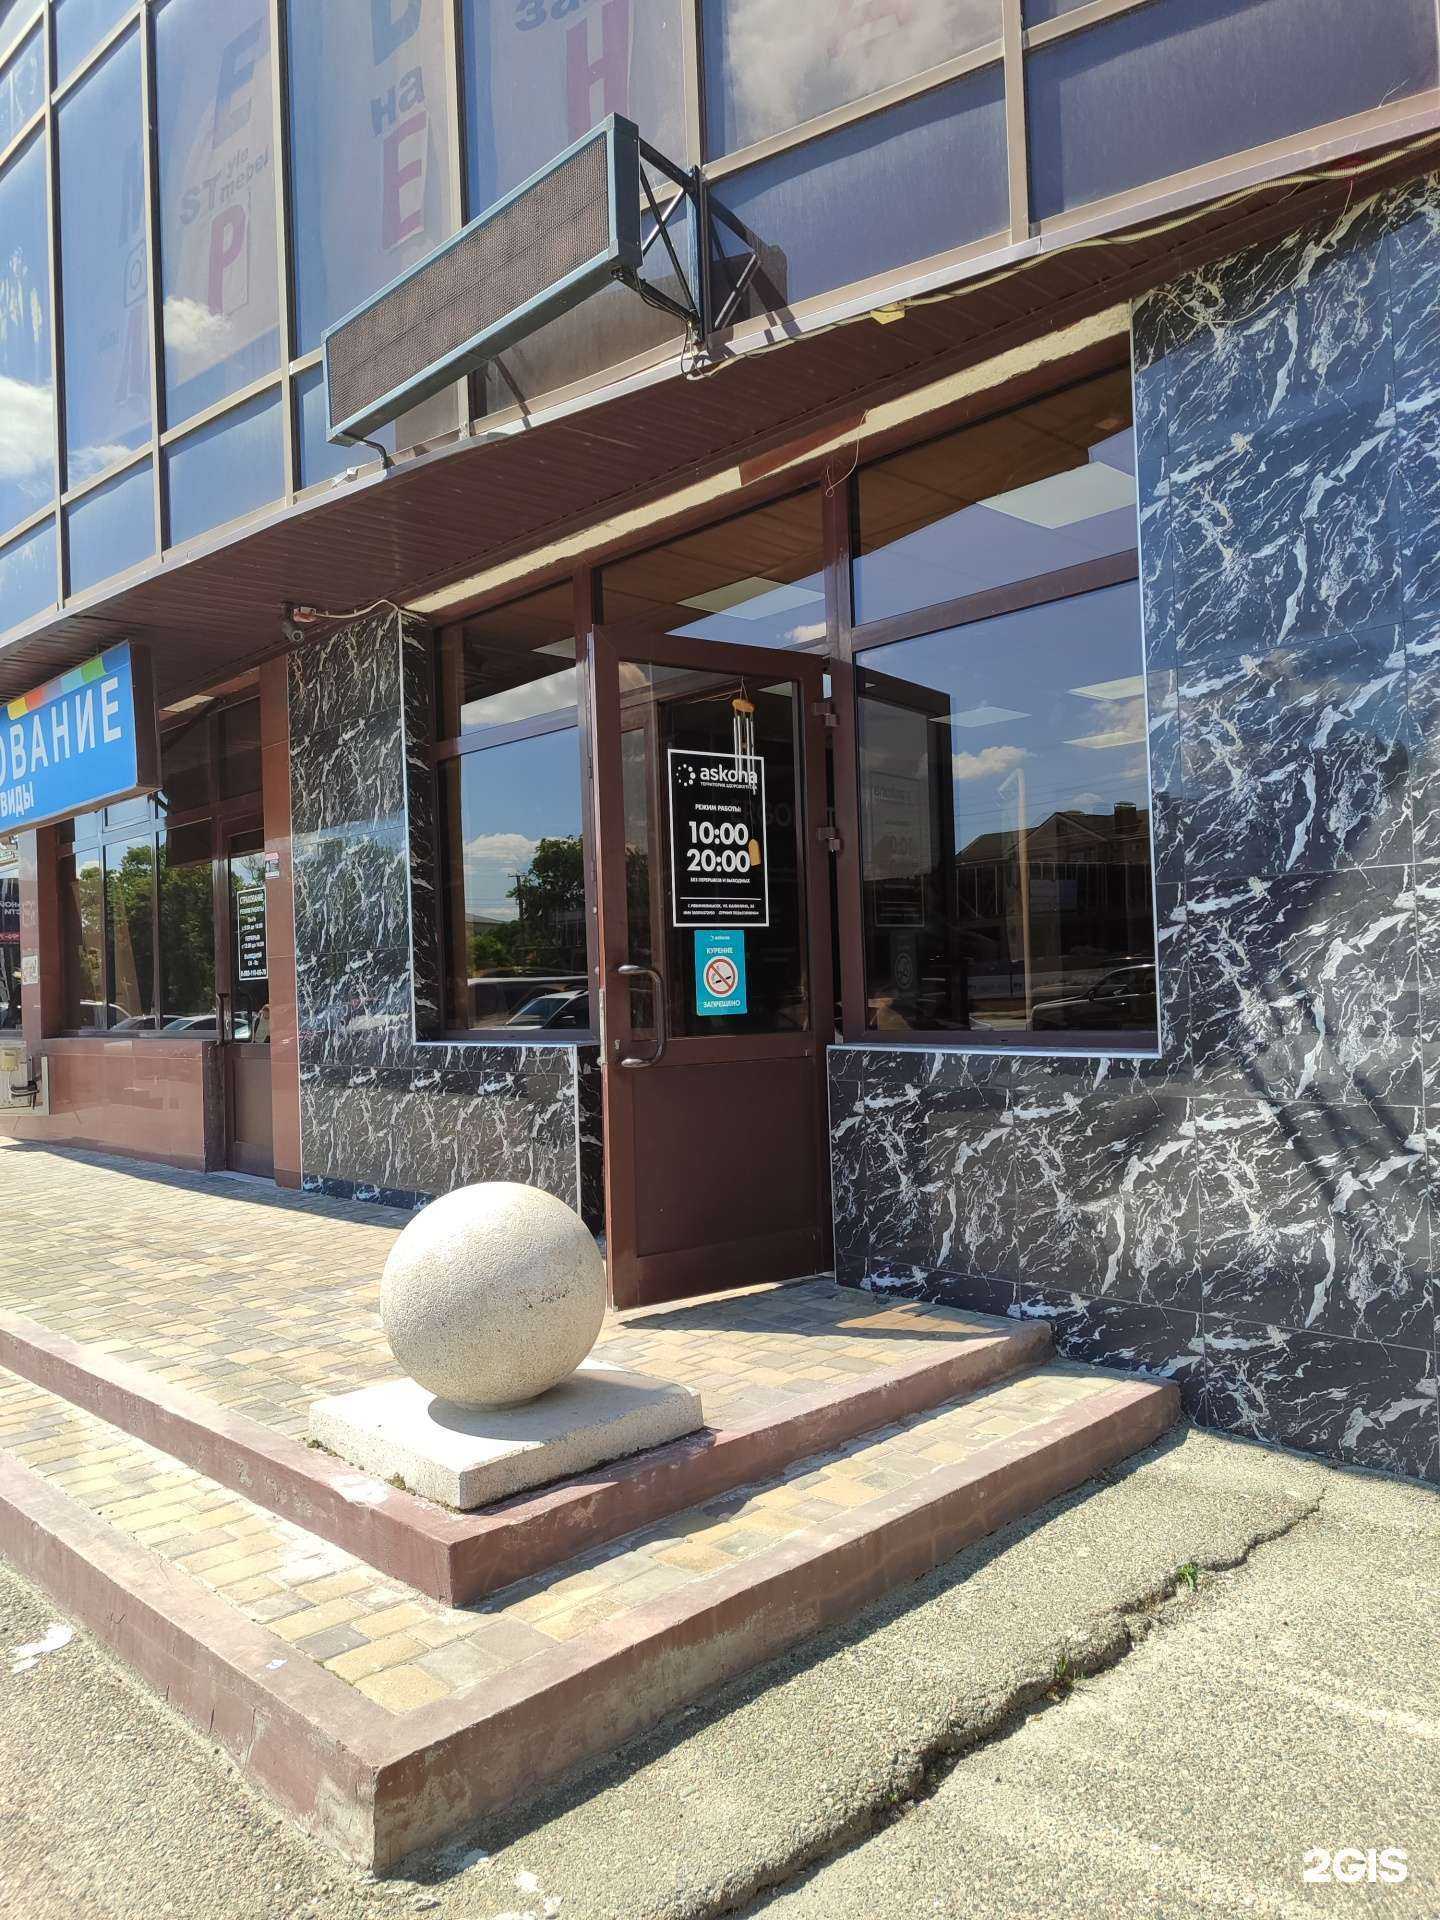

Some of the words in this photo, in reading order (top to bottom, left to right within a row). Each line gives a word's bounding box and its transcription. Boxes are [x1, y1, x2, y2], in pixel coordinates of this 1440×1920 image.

[700, 763, 758, 784] askona
[1, 781, 35, 818] ВИДЫ
[694, 803, 717, 811] РЕЖИМ
[688, 821, 749, 846] 10:00
[687, 848, 751, 873] 20:00
[705, 946, 734, 955] КУРЕНИЕ
